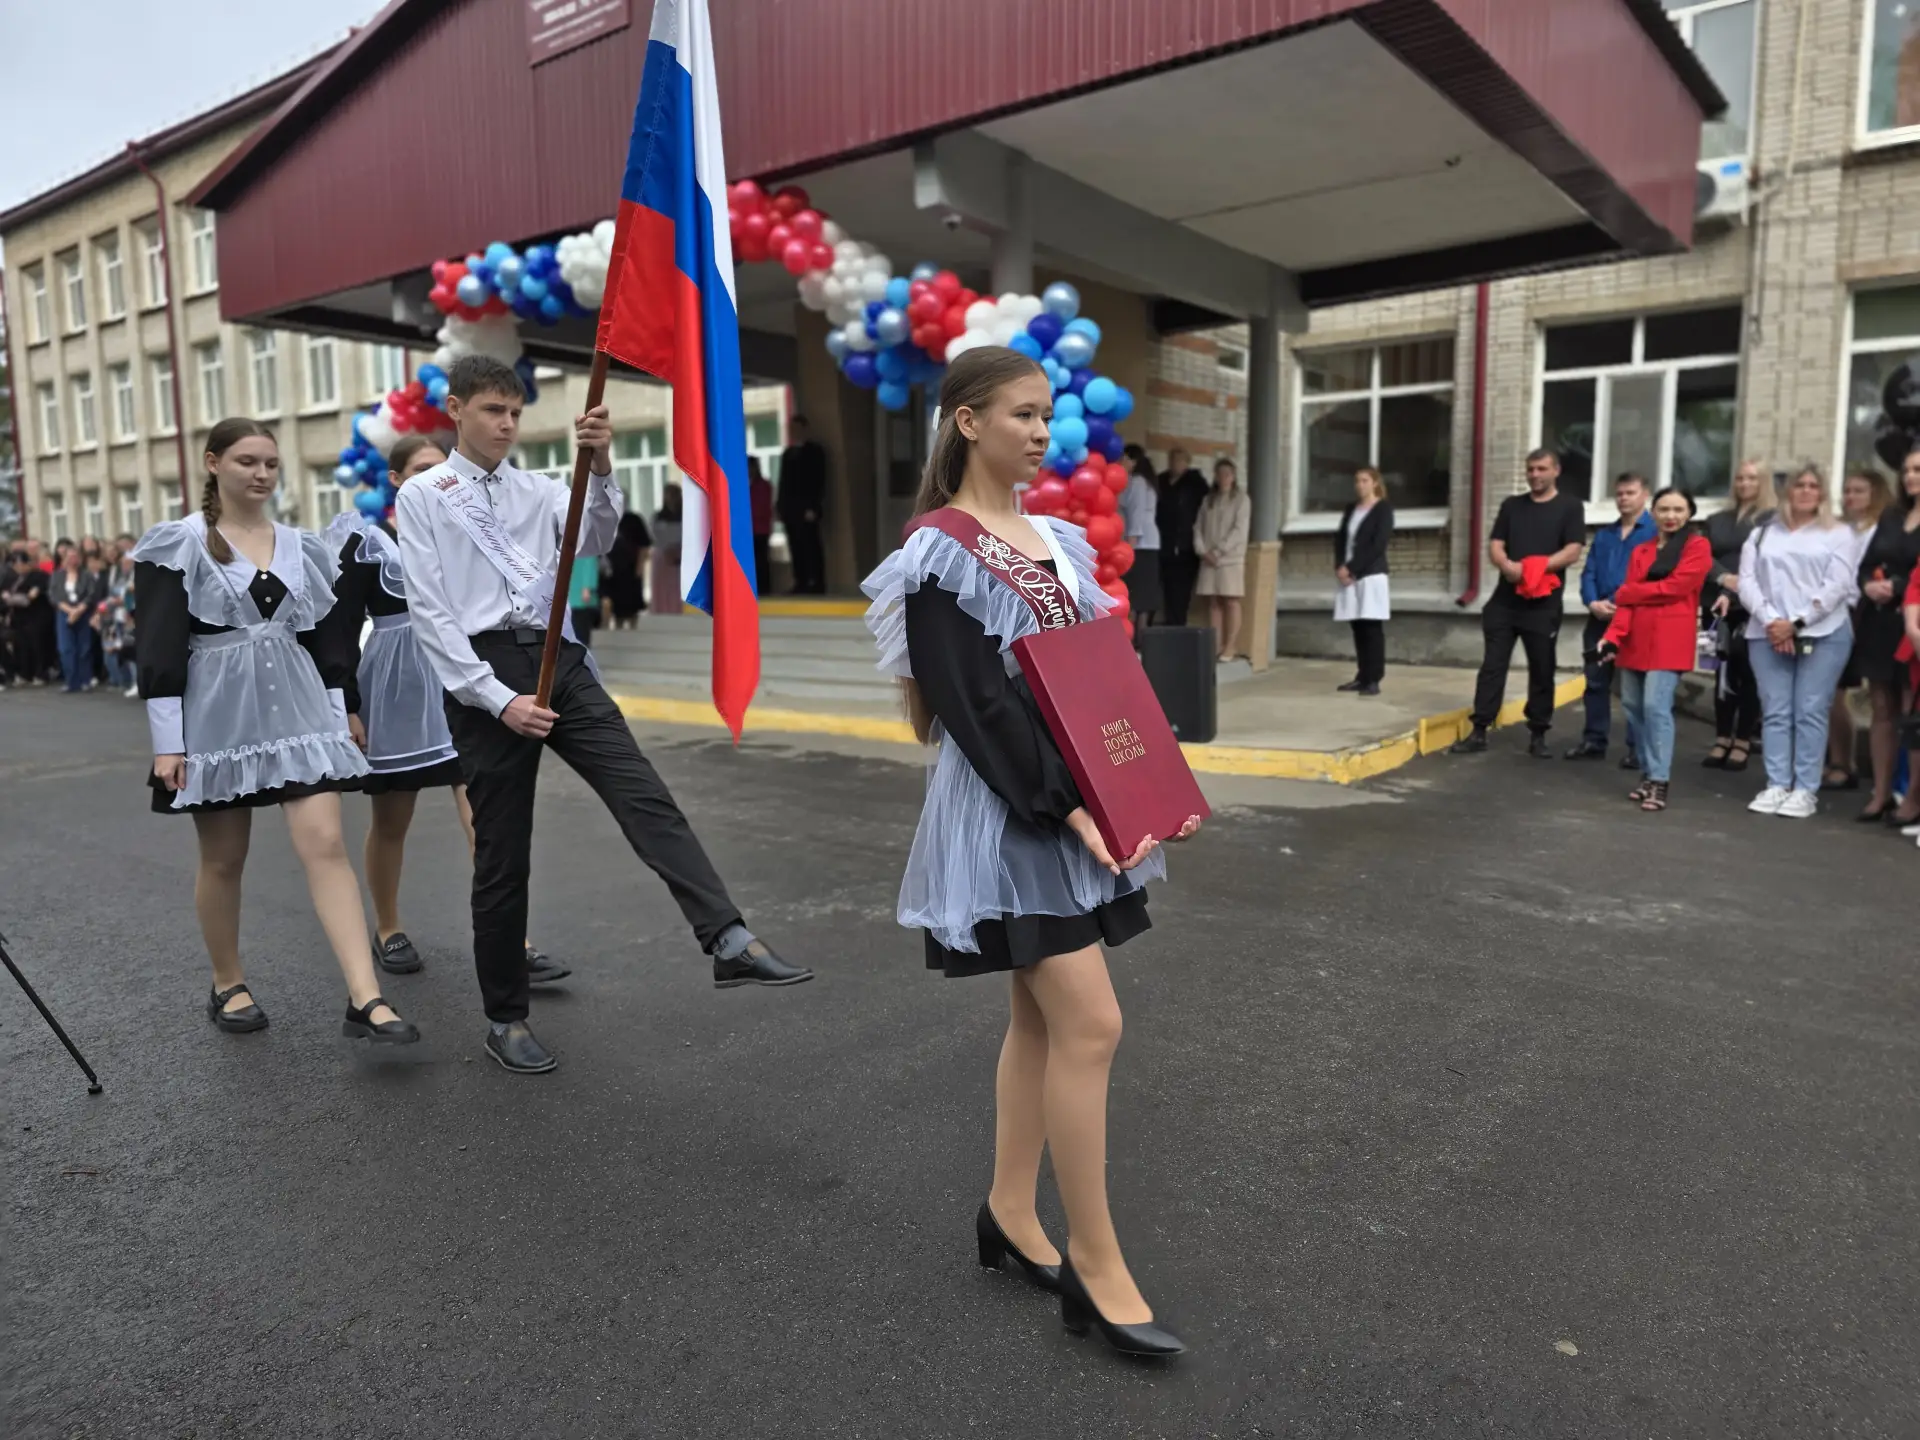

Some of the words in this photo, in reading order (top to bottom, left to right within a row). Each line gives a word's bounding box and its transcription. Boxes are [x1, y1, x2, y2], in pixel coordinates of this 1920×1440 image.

[1010, 564, 1066, 630] Выпу
[1100, 718, 1132, 738] КНИГА
[1109, 742, 1146, 766] ШКОЛЫ
